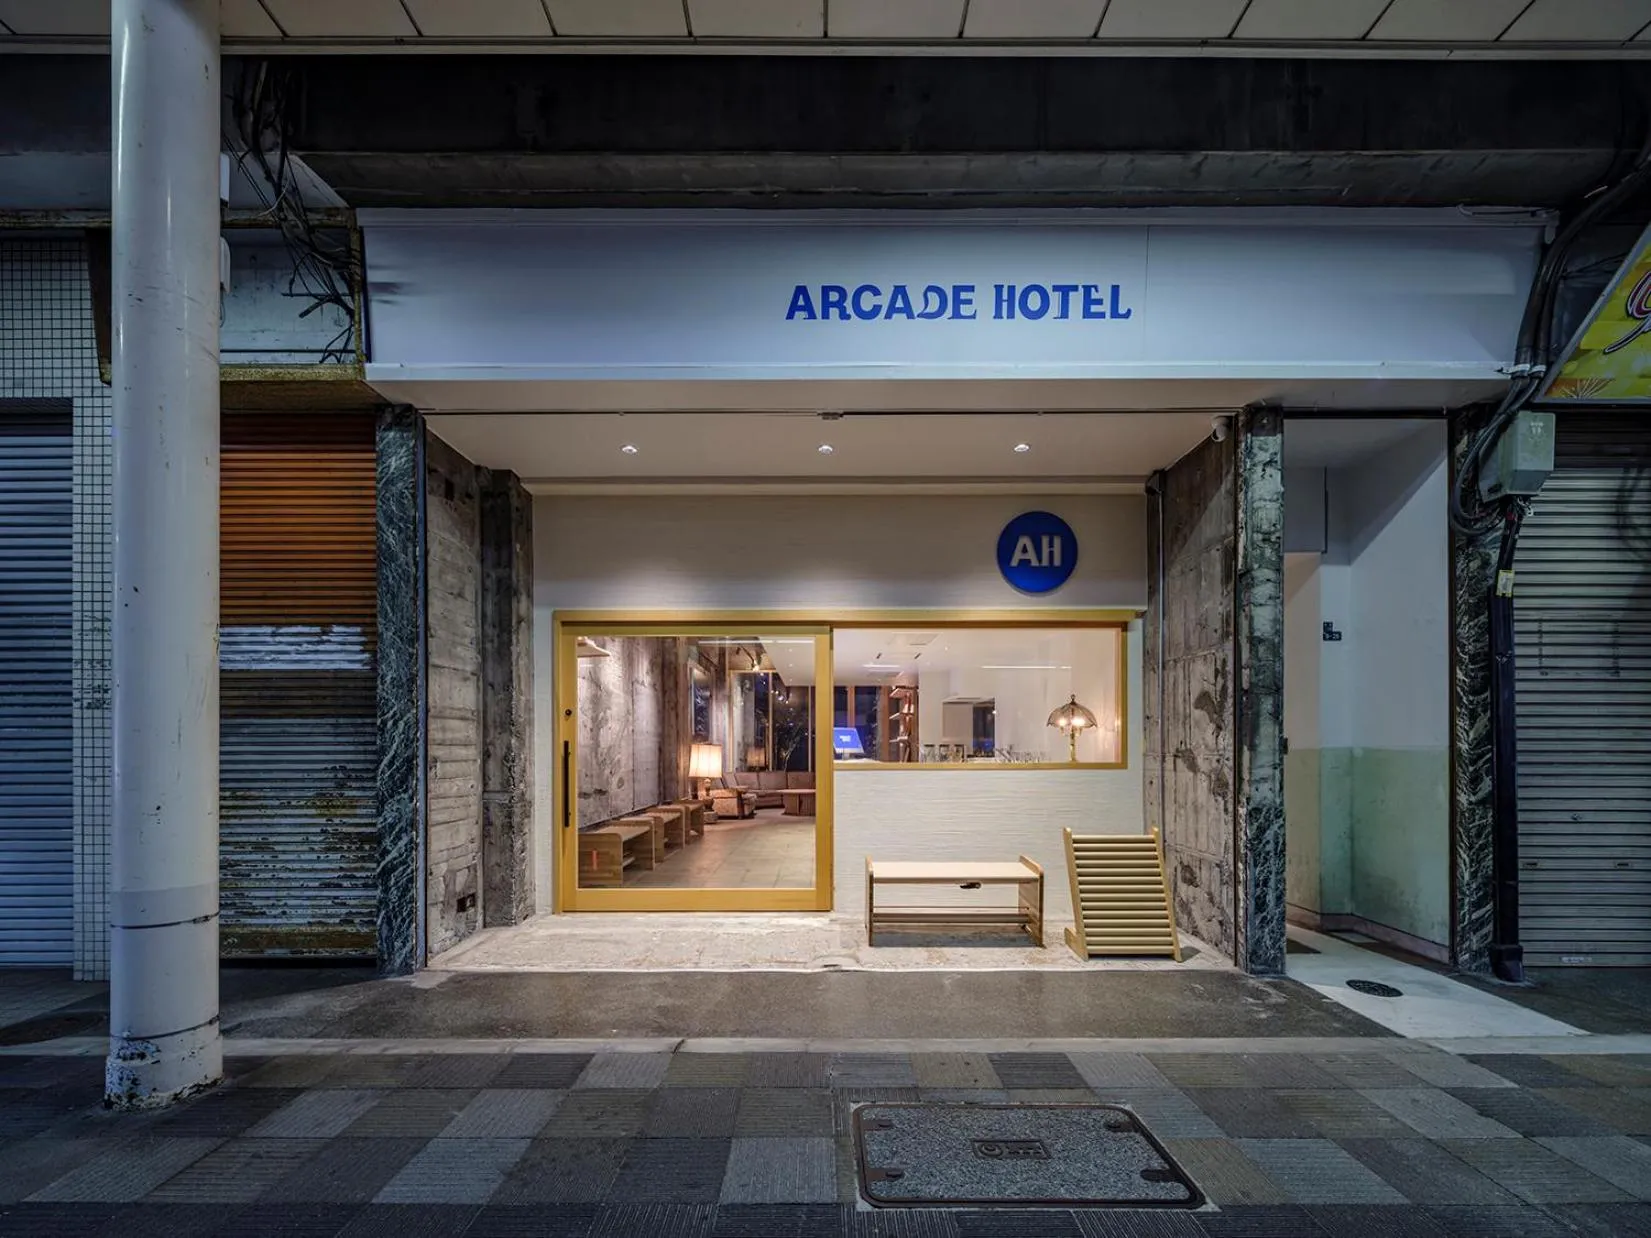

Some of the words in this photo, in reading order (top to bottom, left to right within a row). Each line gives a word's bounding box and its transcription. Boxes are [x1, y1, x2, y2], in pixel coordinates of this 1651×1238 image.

[785, 284, 977, 320] ARCADE
[993, 284, 1132, 320] HOTEL
[1010, 535, 1062, 567] AH
